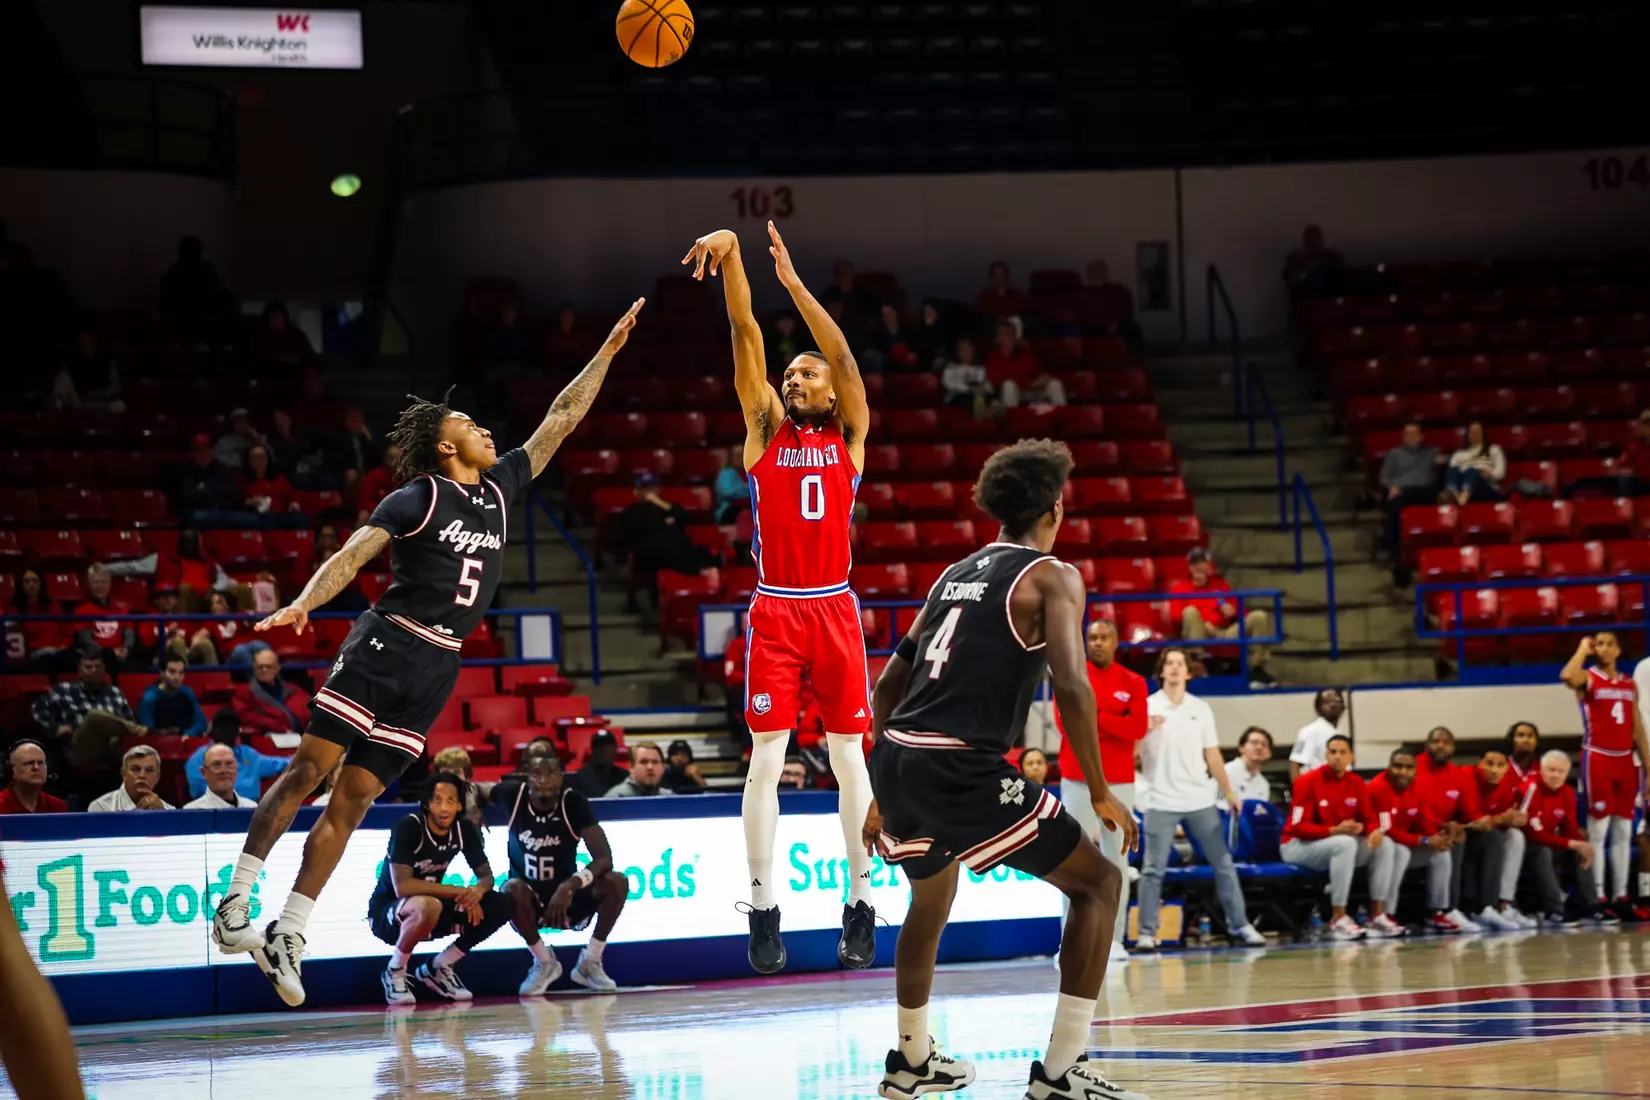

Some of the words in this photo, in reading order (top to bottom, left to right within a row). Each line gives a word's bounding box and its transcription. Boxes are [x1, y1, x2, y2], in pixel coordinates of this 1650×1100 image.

[193, 34, 234, 49] Willis
[237, 36, 307, 54] Knighton
[1582, 155, 1650, 190] 104
[730, 186, 795, 218] 103
[801, 474, 825, 521] 0
[438, 519, 501, 554] Aggies
[453, 556, 484, 608] 5
[924, 605, 963, 680] 4
[1611, 701, 1624, 725] 4
[523, 852, 555, 881] 66
[37, 854, 95, 962] 1
